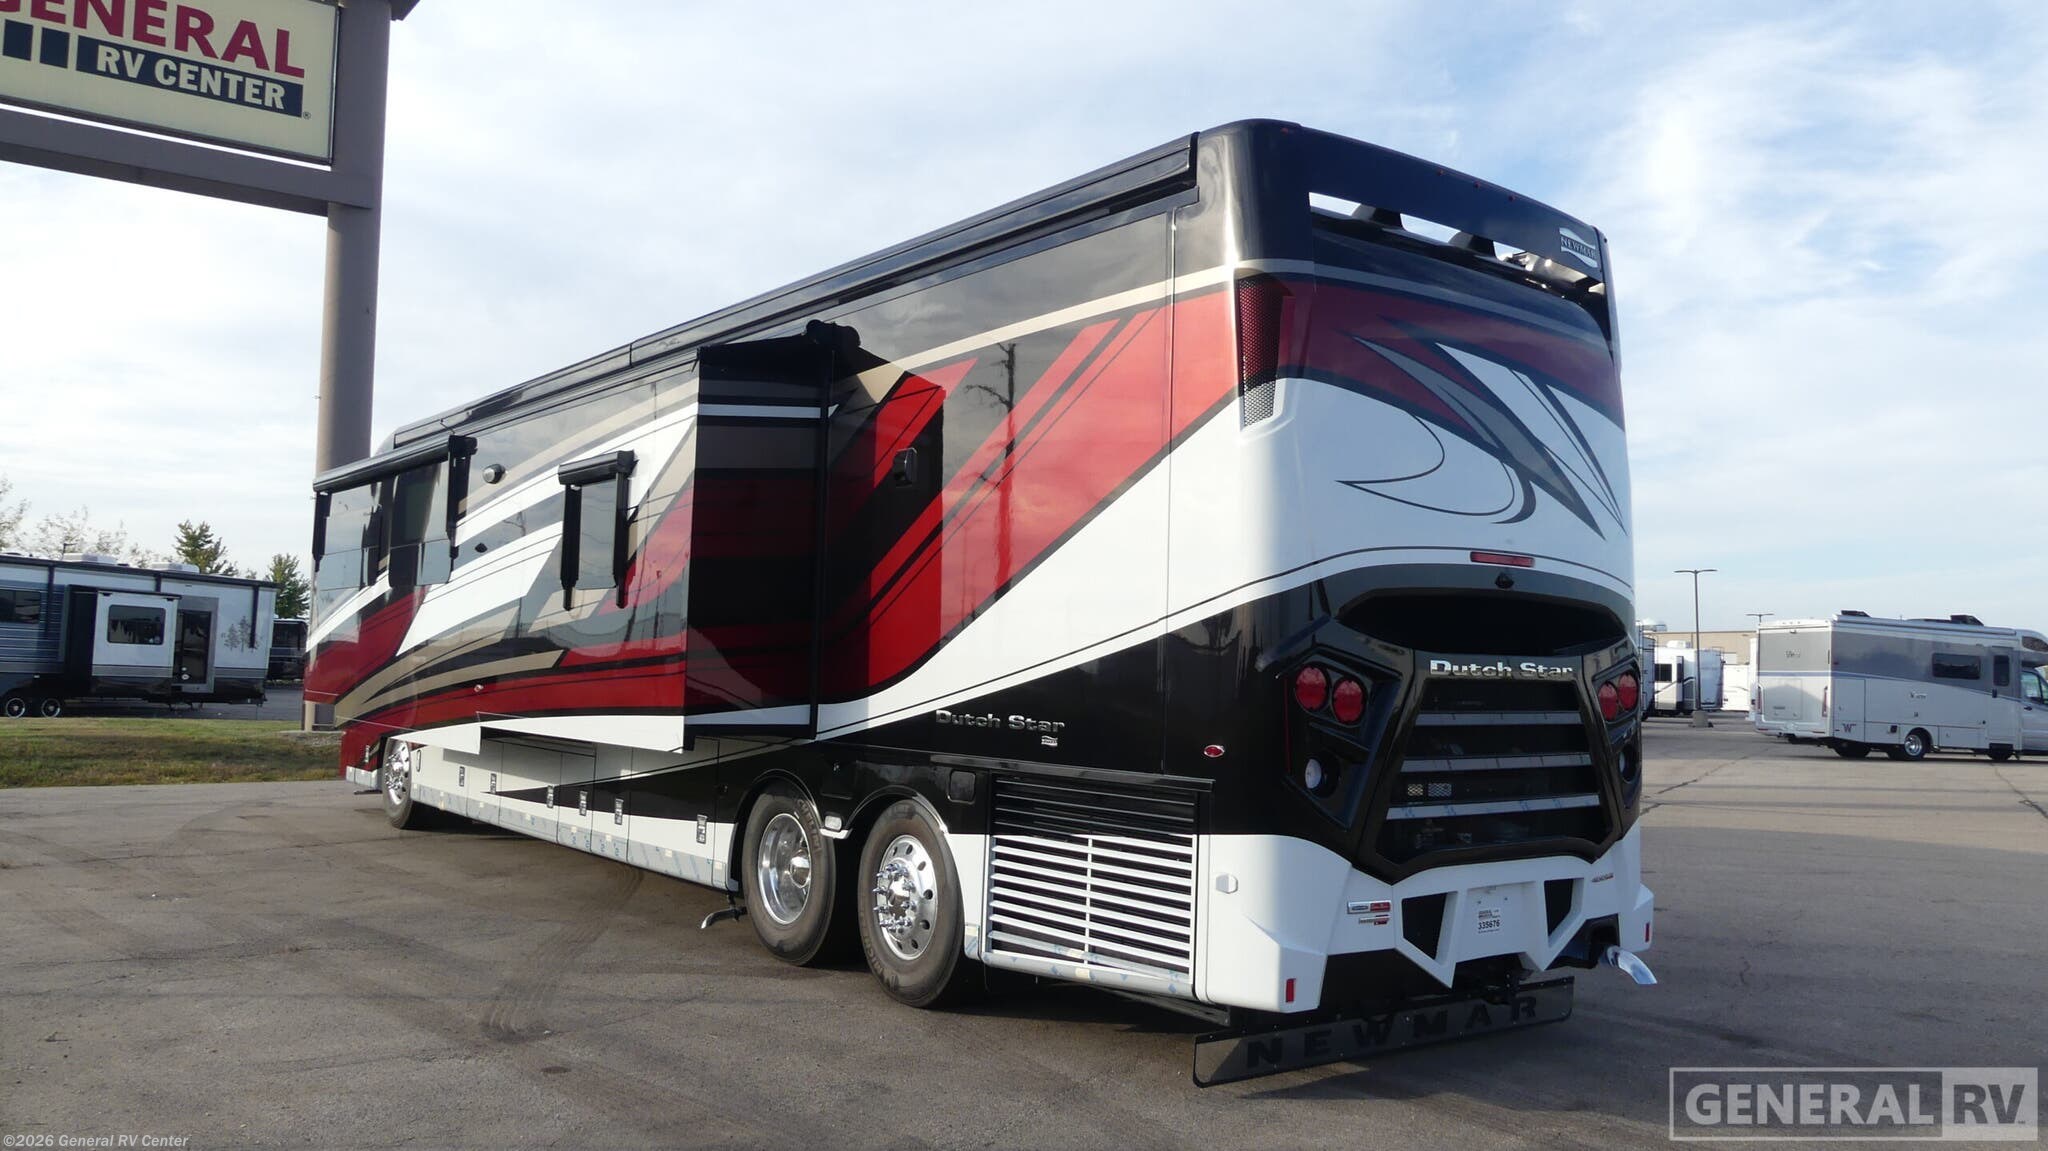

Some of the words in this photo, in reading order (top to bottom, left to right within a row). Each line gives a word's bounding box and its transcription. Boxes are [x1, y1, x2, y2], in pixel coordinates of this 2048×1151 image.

[97, 45, 144, 78] RV
[154, 59, 286, 110] CENTER
[1430, 659, 1512, 678] Dutch
[1520, 662, 1573, 678] Star
[936, 709, 1001, 728] Dutch
[1008, 714, 1065, 733] Star
[1246, 996, 1537, 1068] NEWMAR
